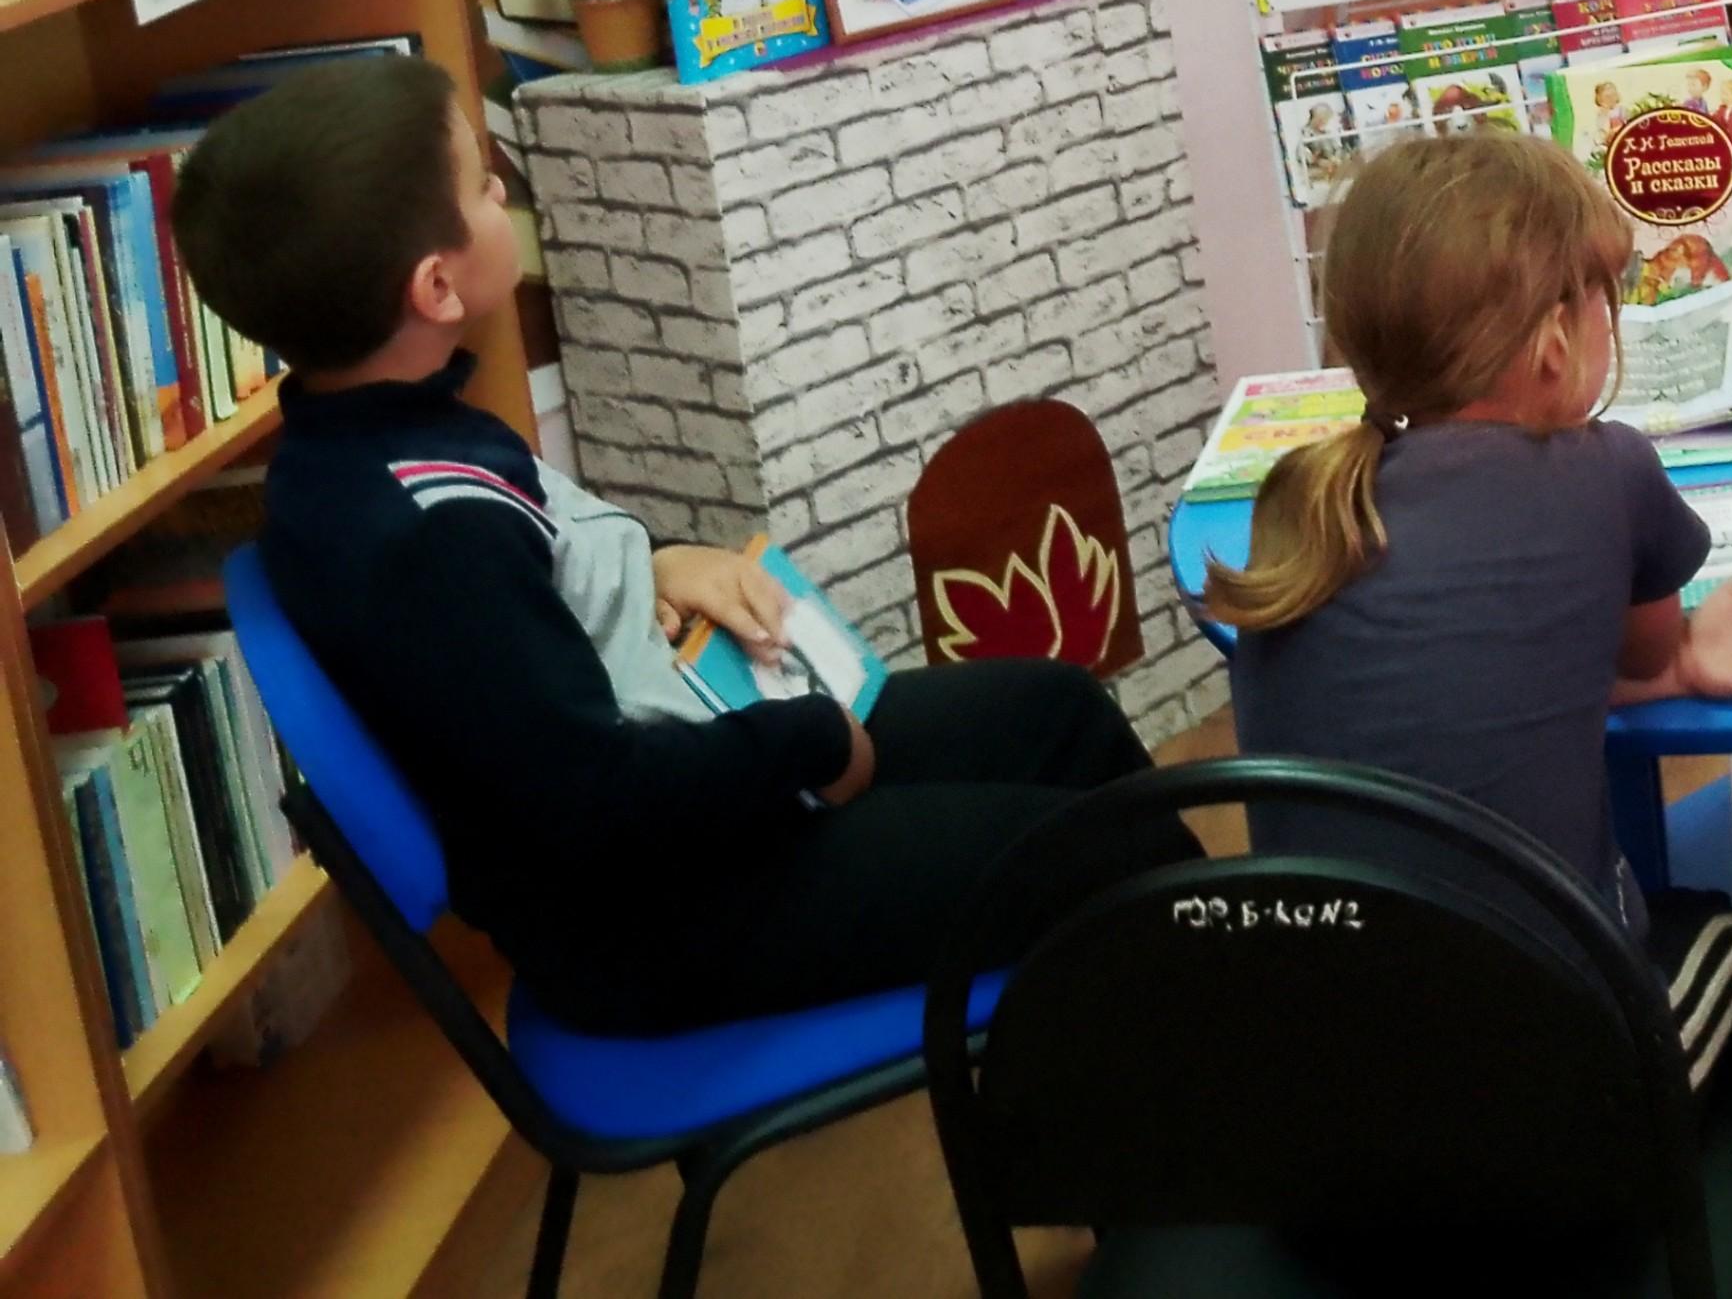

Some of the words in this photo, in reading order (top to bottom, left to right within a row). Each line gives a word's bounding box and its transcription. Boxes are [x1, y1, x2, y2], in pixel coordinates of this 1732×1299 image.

[1624, 156, 1721, 180] Рассказы
[1631, 181, 1644, 194] и
[1650, 175, 1719, 193] сказки
